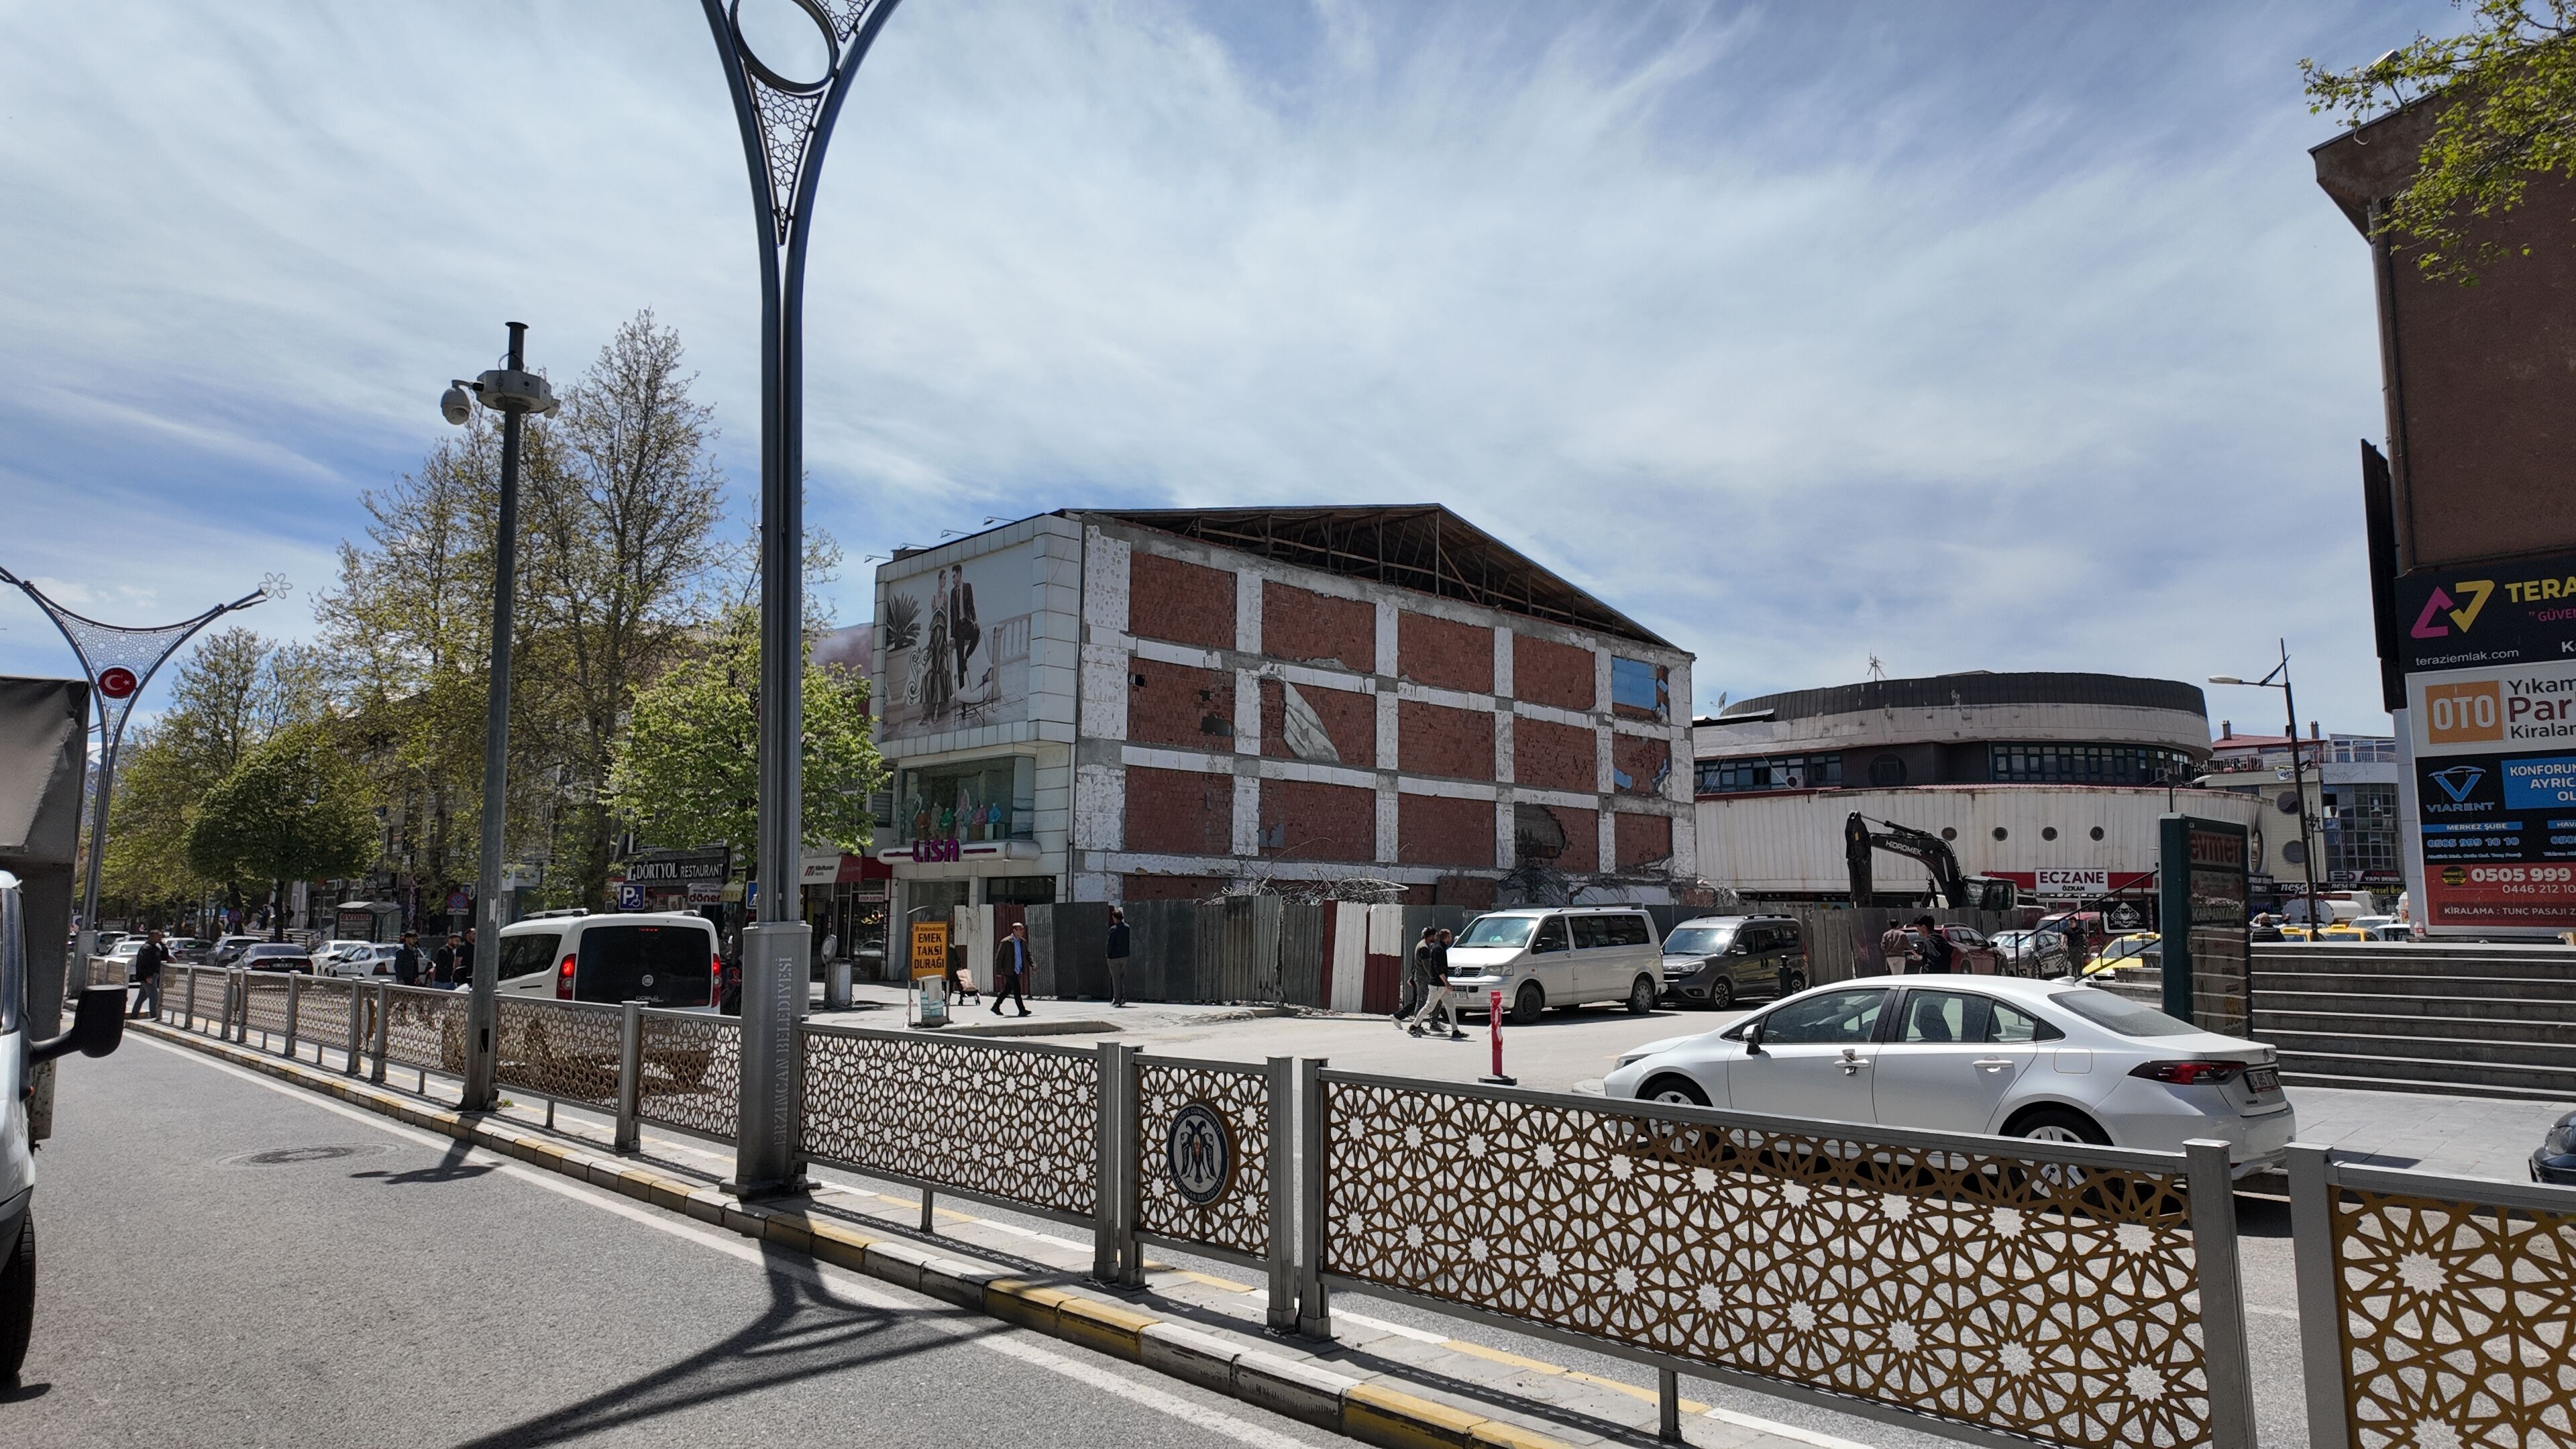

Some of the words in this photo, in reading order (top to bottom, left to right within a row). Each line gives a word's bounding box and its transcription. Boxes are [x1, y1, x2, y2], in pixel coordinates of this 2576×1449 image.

[2505, 576, 2576, 602] TERA
[2561, 640, 2576, 653] K
[2416, 649, 2520, 666] teraziemlak.com
[2432, 695, 2496, 731] OTO
[2508, 692, 2576, 722] Par
[2426, 802, 2495, 813] VIARENT
[2447, 822, 2482, 831] MERKEZ
[2484, 822, 2507, 831] ŞUBE
[2427, 839, 2457, 848] 0505
[2485, 837, 2501, 847] 10
[2504, 837, 2520, 846] 10
[637, 861, 678, 879] DÖRTYOL
[680, 863, 723, 878] RESTAURANT
[2471, 868, 2526, 882] 0505
[2530, 867, 2571, 882] 999
[2039, 871, 2104, 884] ECZANE
[2281, 883, 2316, 896] neşe
[2502, 884, 2535, 894] 0446
[2539, 884, 2559, 894] 212
[623, 887, 635, 905] P
[2445, 906, 2494, 915] KİRALAMA
[2502, 908, 2529, 916] TUNÇ
[2532, 908, 2567, 916] PASAJI
[918, 932, 942, 943] EMEK
[916, 943, 943, 956] TAKSİ
[914, 957, 945, 969] DURAĞI
[775, 957, 792, 1053] BELEDİYESİ
